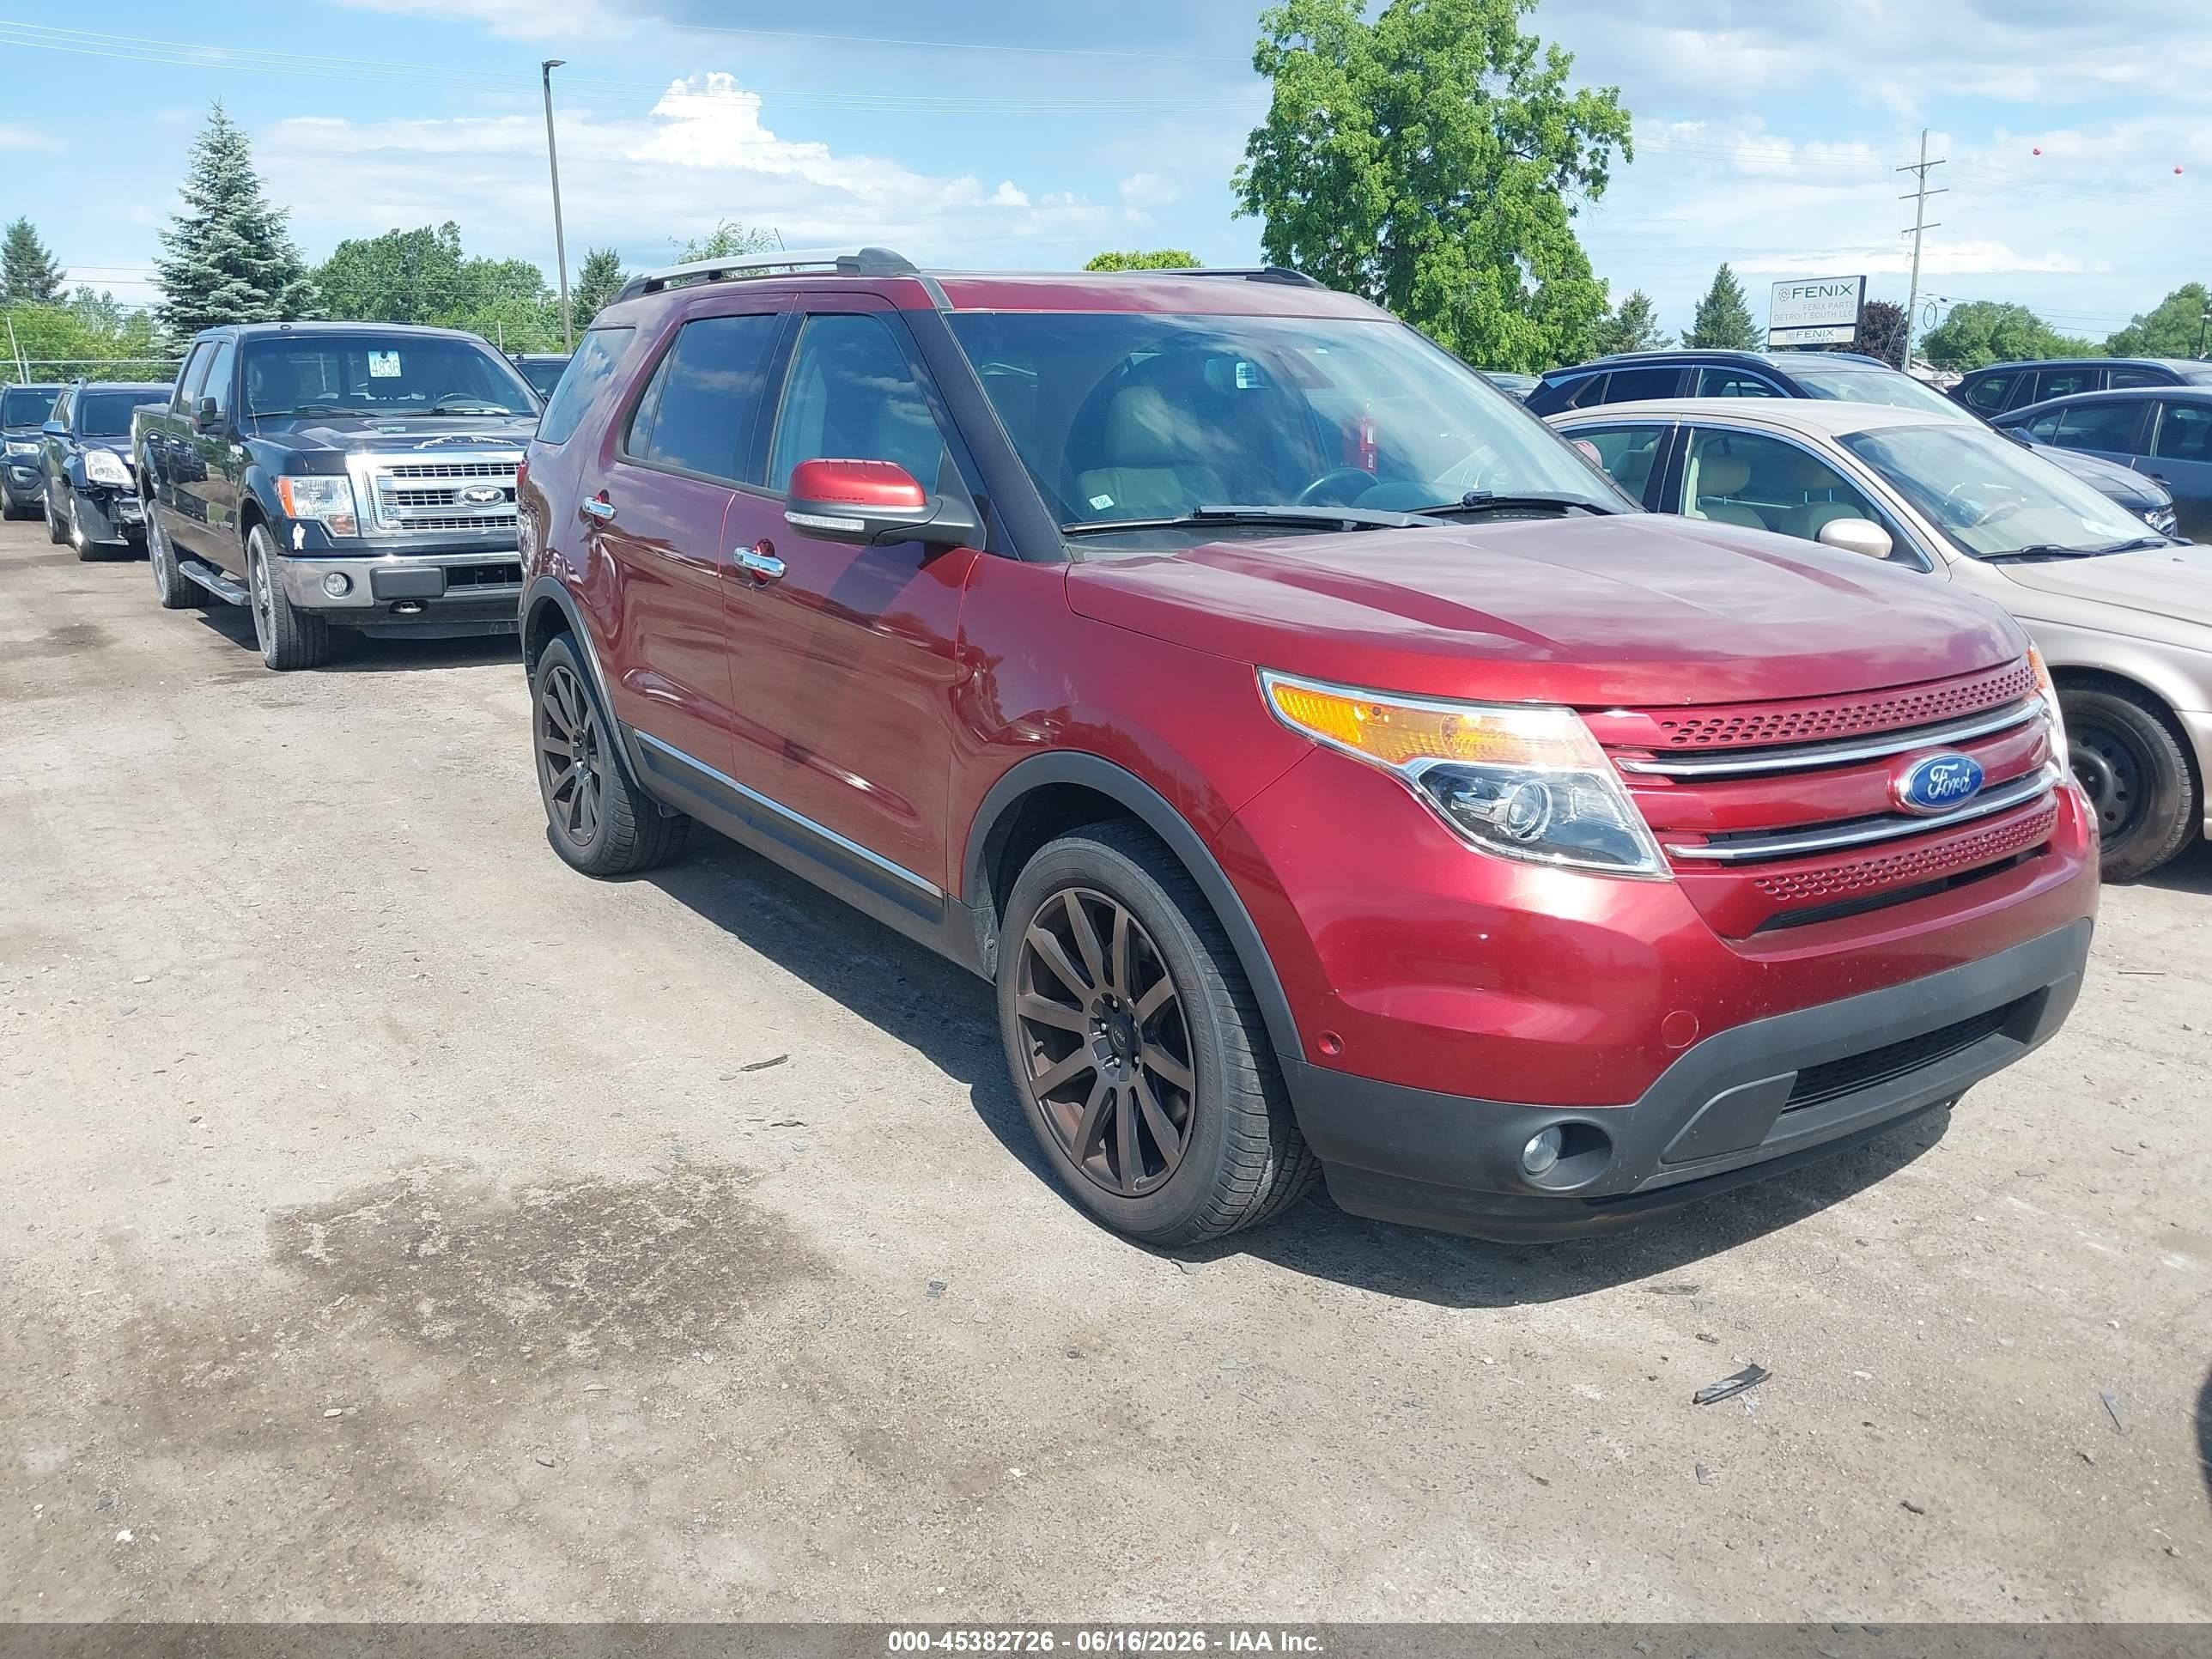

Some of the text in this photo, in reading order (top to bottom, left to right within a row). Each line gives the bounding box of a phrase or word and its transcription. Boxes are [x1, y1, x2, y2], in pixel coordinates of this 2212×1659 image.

[1792, 283, 1853, 299] FENIX
[1774, 313, 1807, 321] DETROIT
[1809, 311, 1837, 319] SOUTH
[1796, 329, 1835, 338] FENIX
[372, 358, 400, 376] 4836
[1927, 763, 1972, 799] Ford
